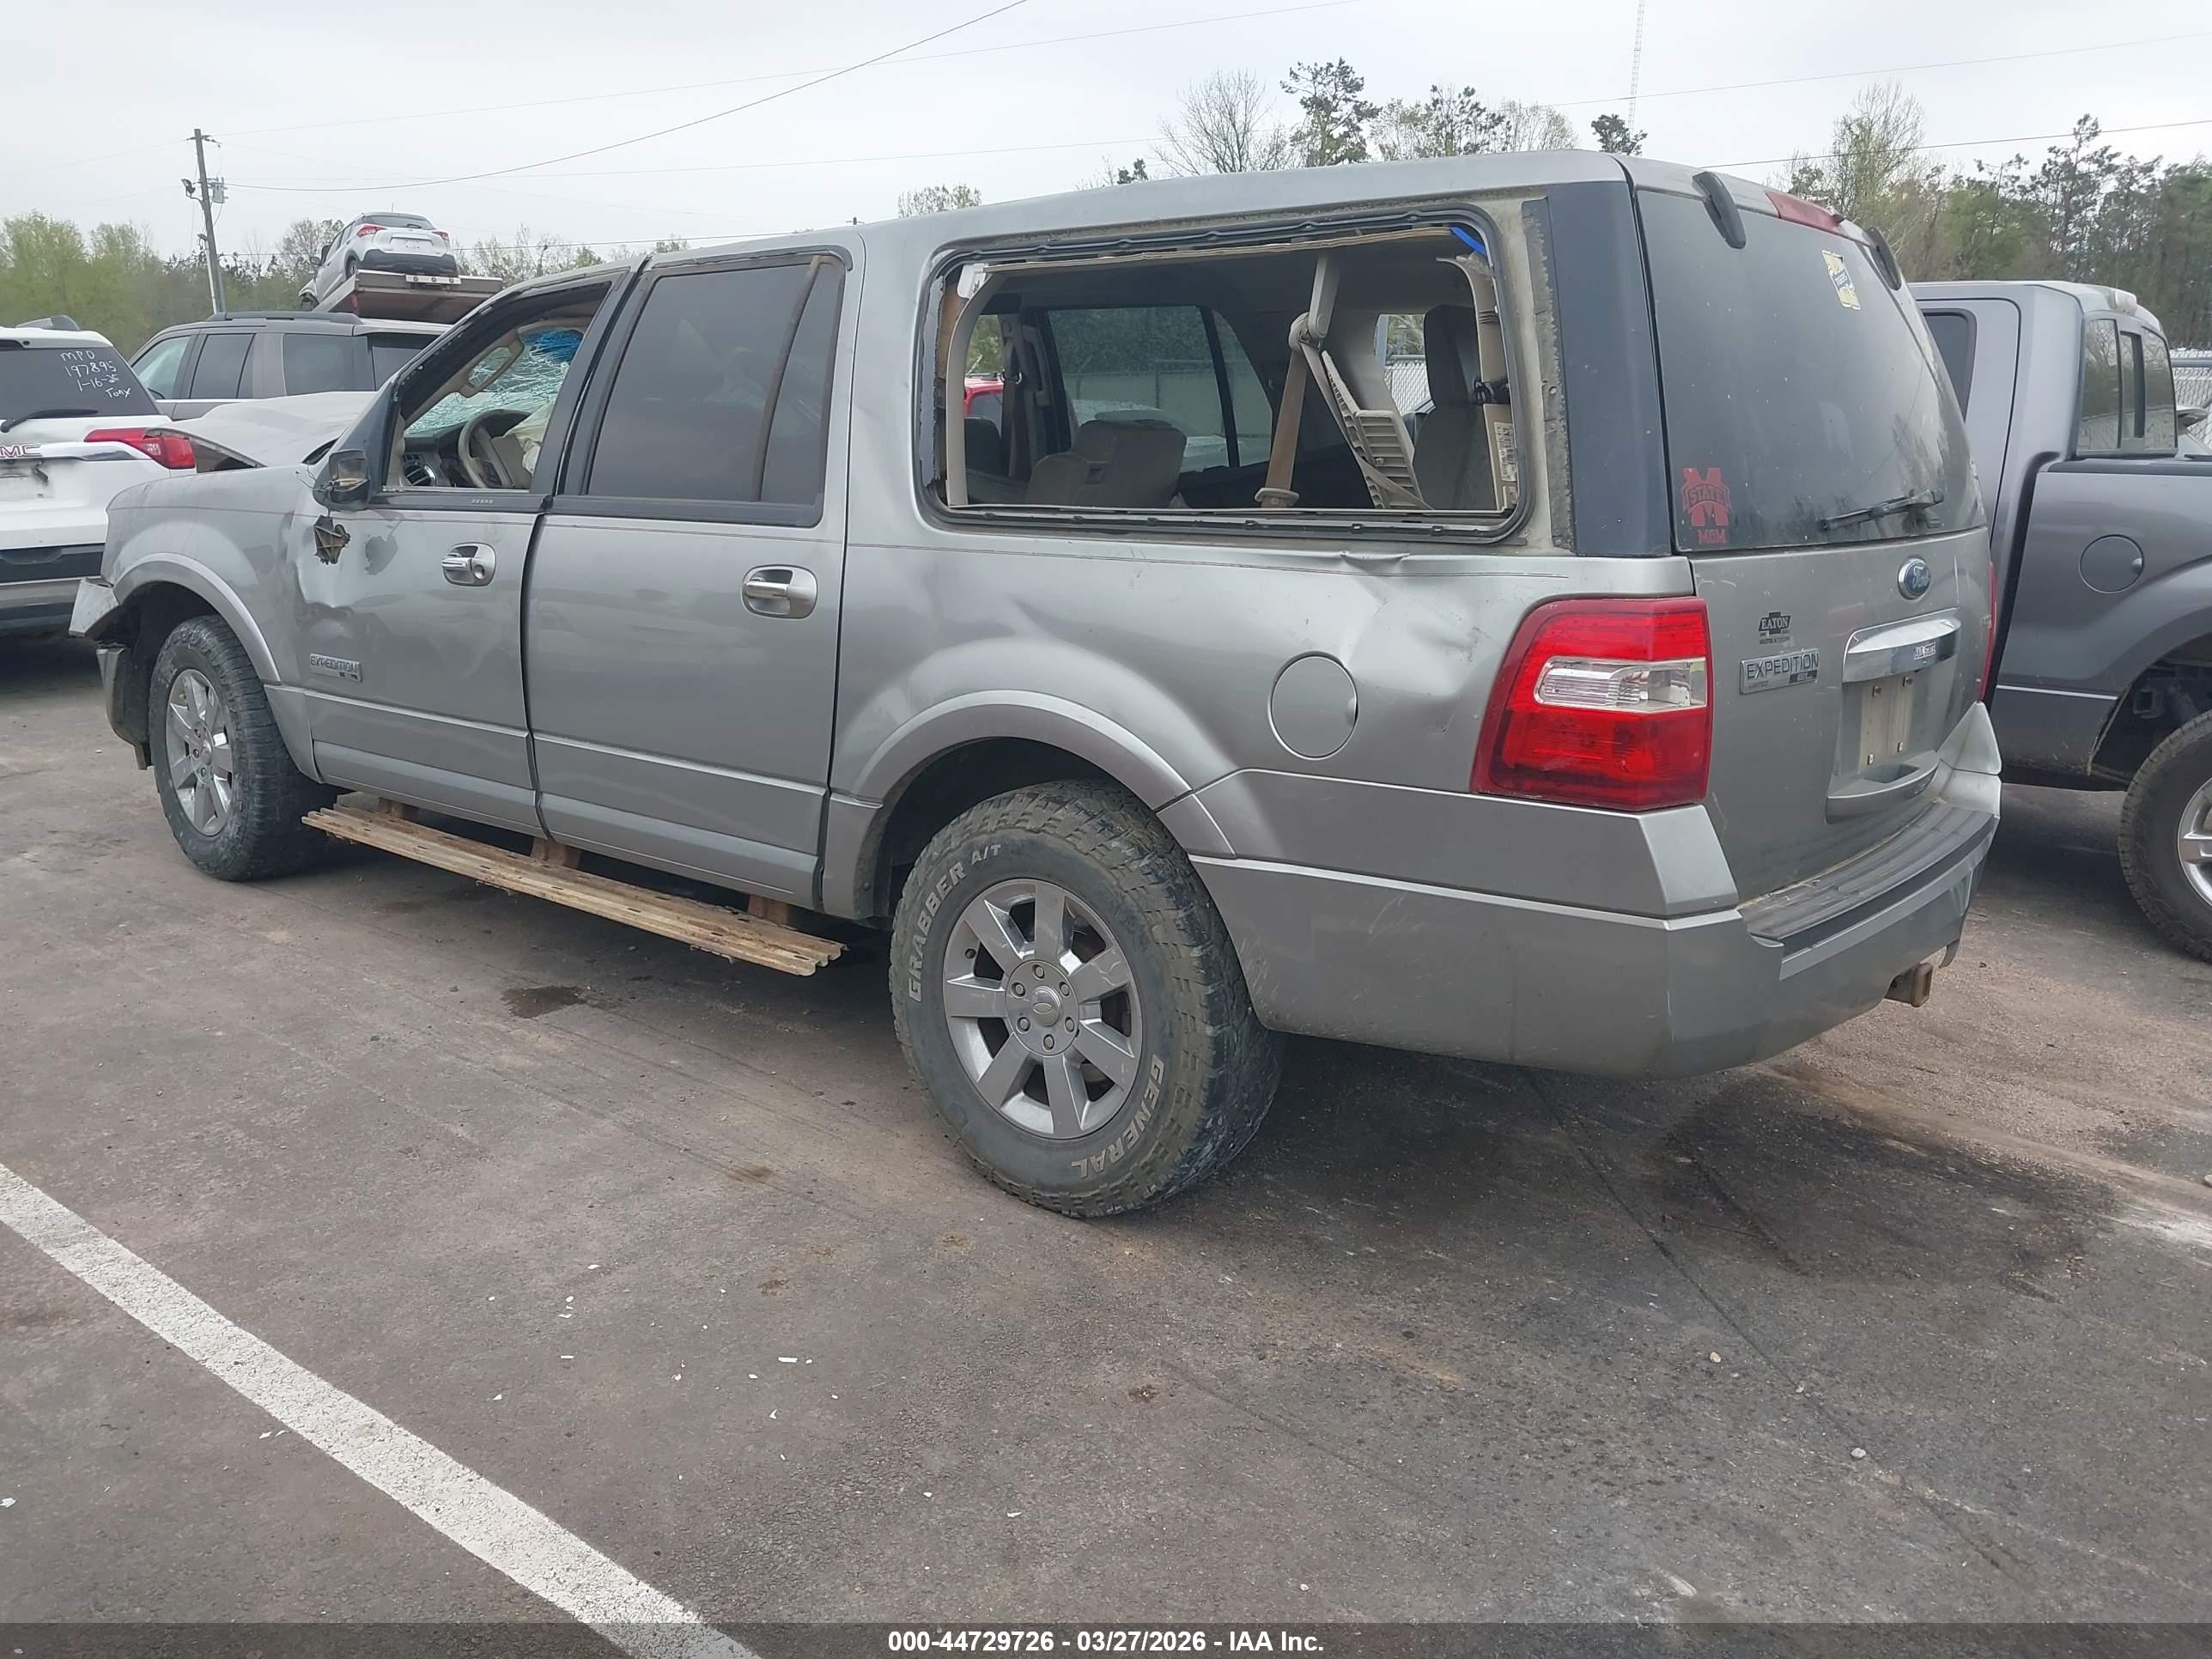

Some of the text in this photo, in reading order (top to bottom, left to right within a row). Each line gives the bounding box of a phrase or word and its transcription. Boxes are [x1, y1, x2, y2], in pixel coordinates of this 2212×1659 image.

[64, 361, 117, 378] 197895
[1689, 484, 1725, 506] STATE
[1697, 528, 1727, 544] MOM
[1761, 617, 1790, 629] EATON
[310, 656, 357, 674] EXPEDITION
[1747, 652, 1820, 680] EXPEDITION
[908, 843, 1003, 1002] GRABBER A/T
[1071, 1054, 1165, 1179] GENERAL
